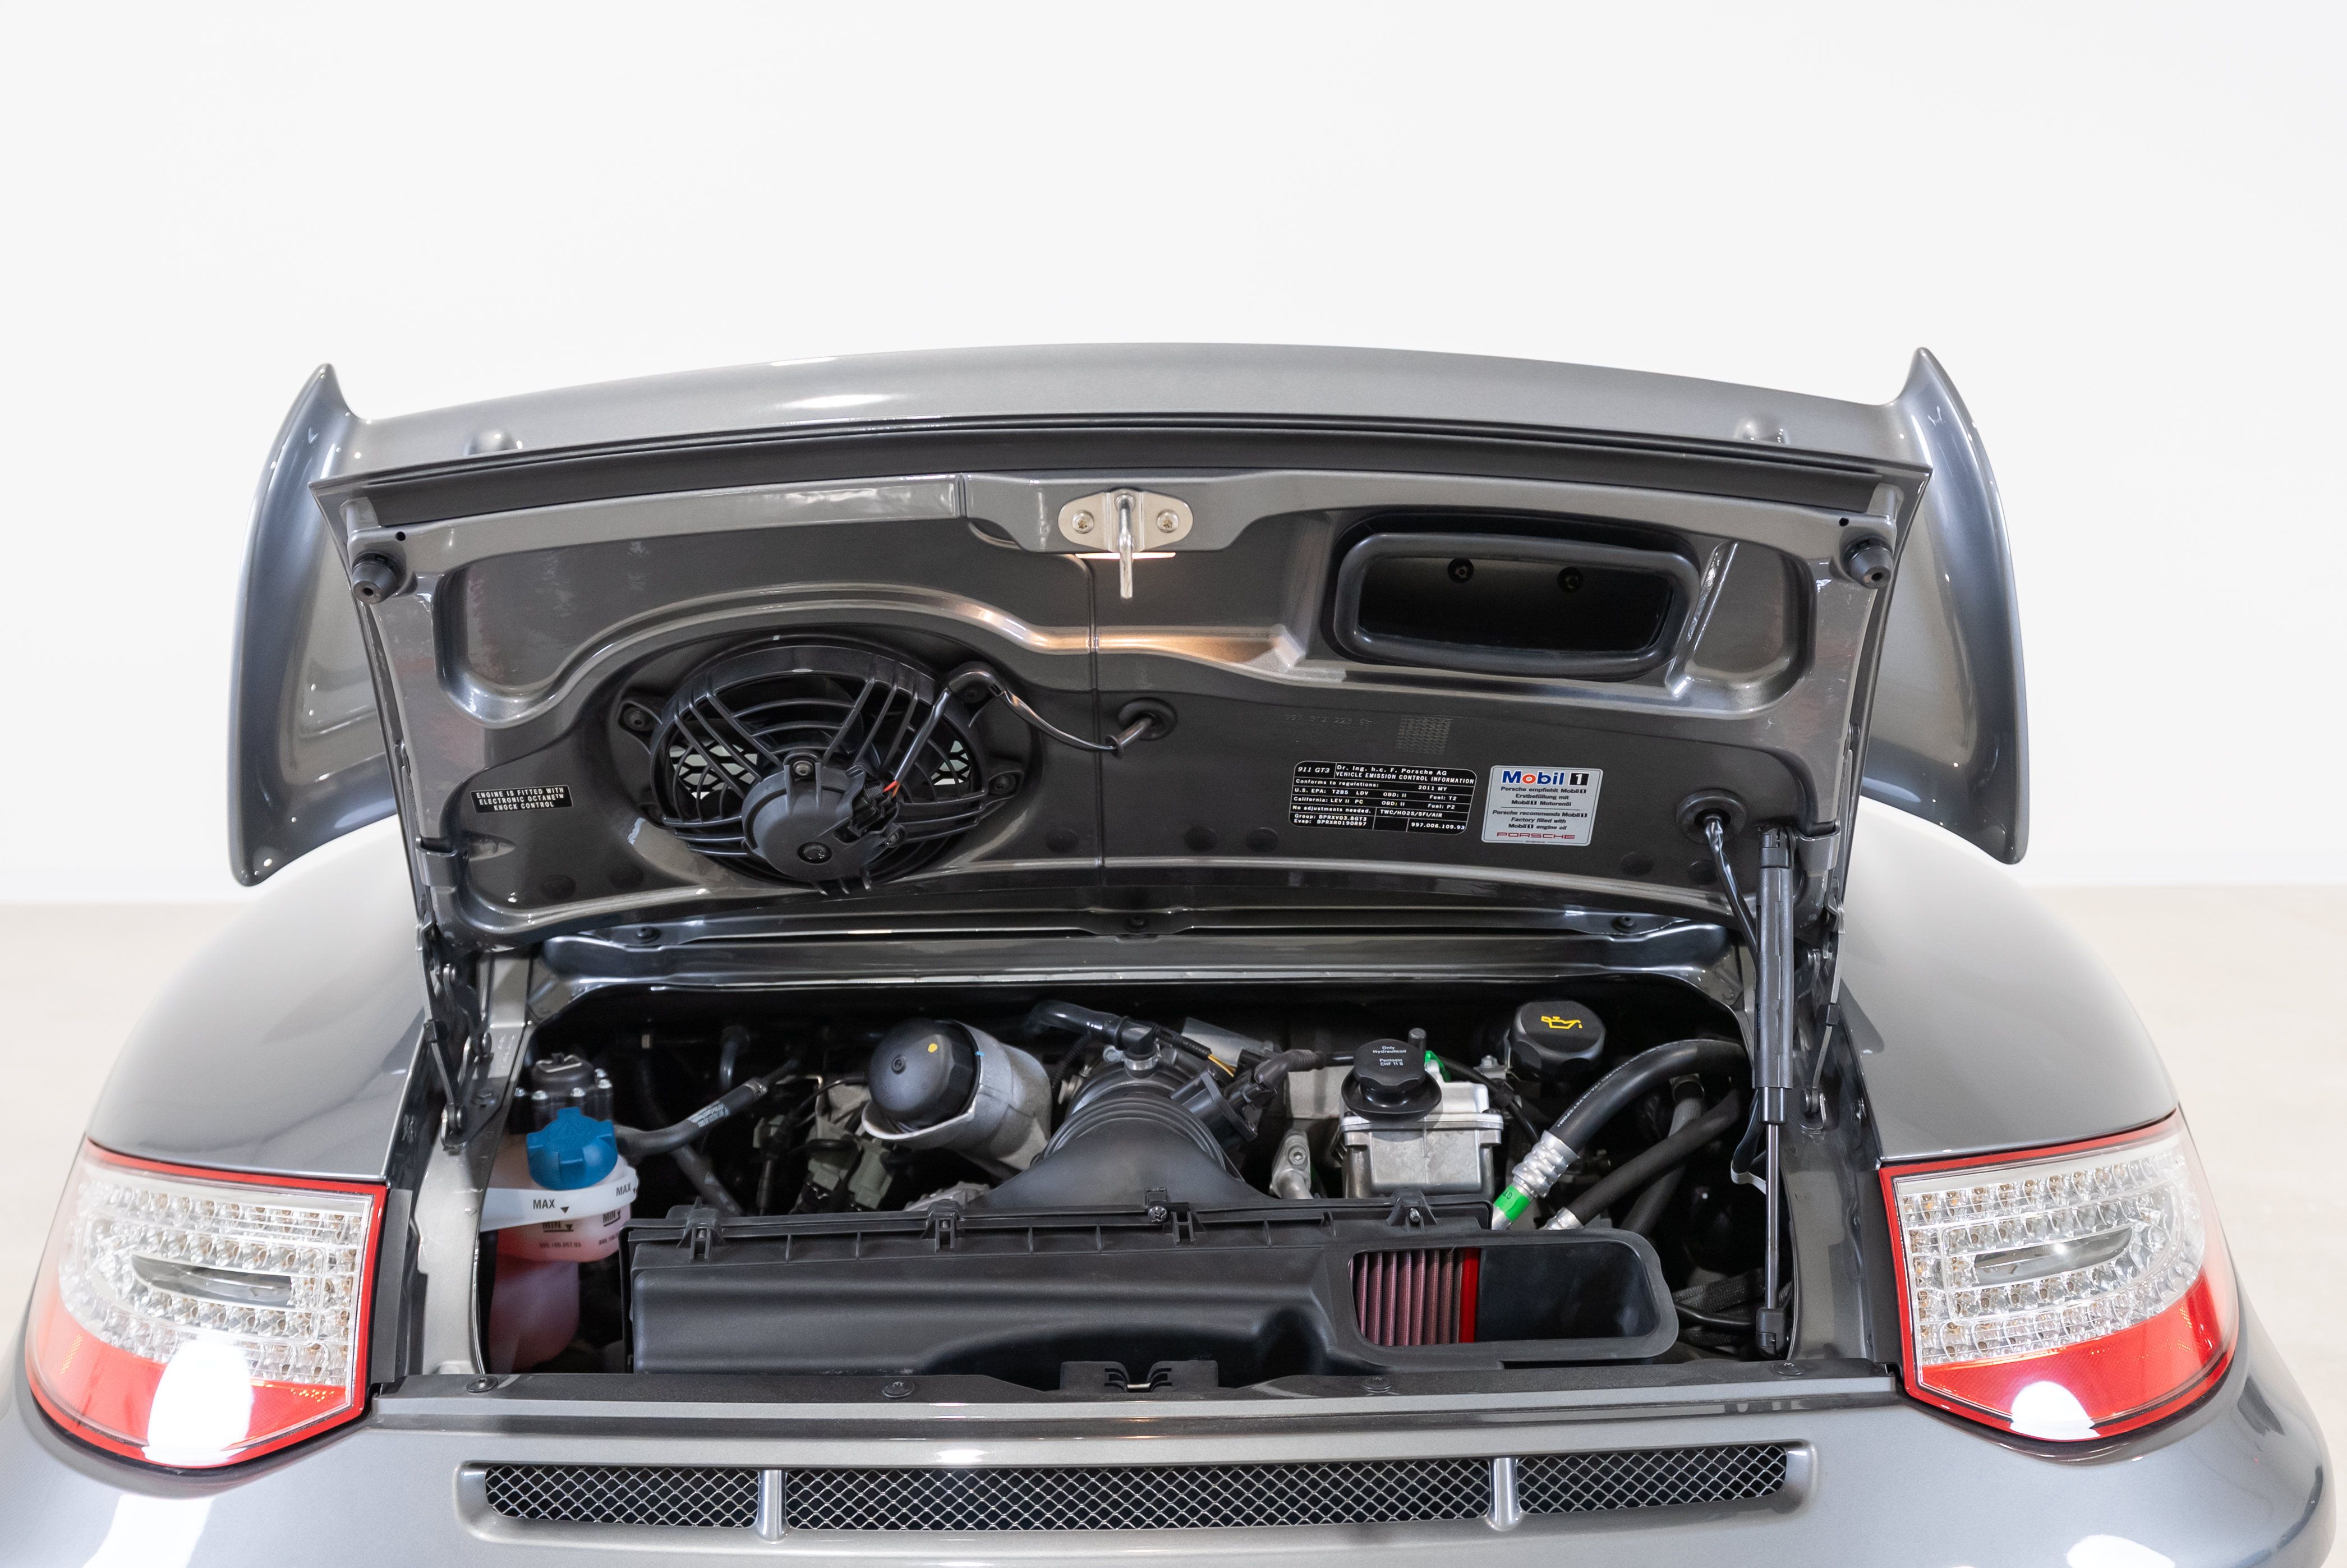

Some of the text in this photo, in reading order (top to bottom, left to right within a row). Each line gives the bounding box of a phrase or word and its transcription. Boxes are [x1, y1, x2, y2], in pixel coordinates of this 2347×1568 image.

[1502, 771, 1564, 785] Mobil
[478, 797, 524, 805] ELECTRONIC
[616, 1183, 631, 1196] MAX
[533, 1199, 555, 1210] MAX
[603, 1210, 616, 1223] MIN
